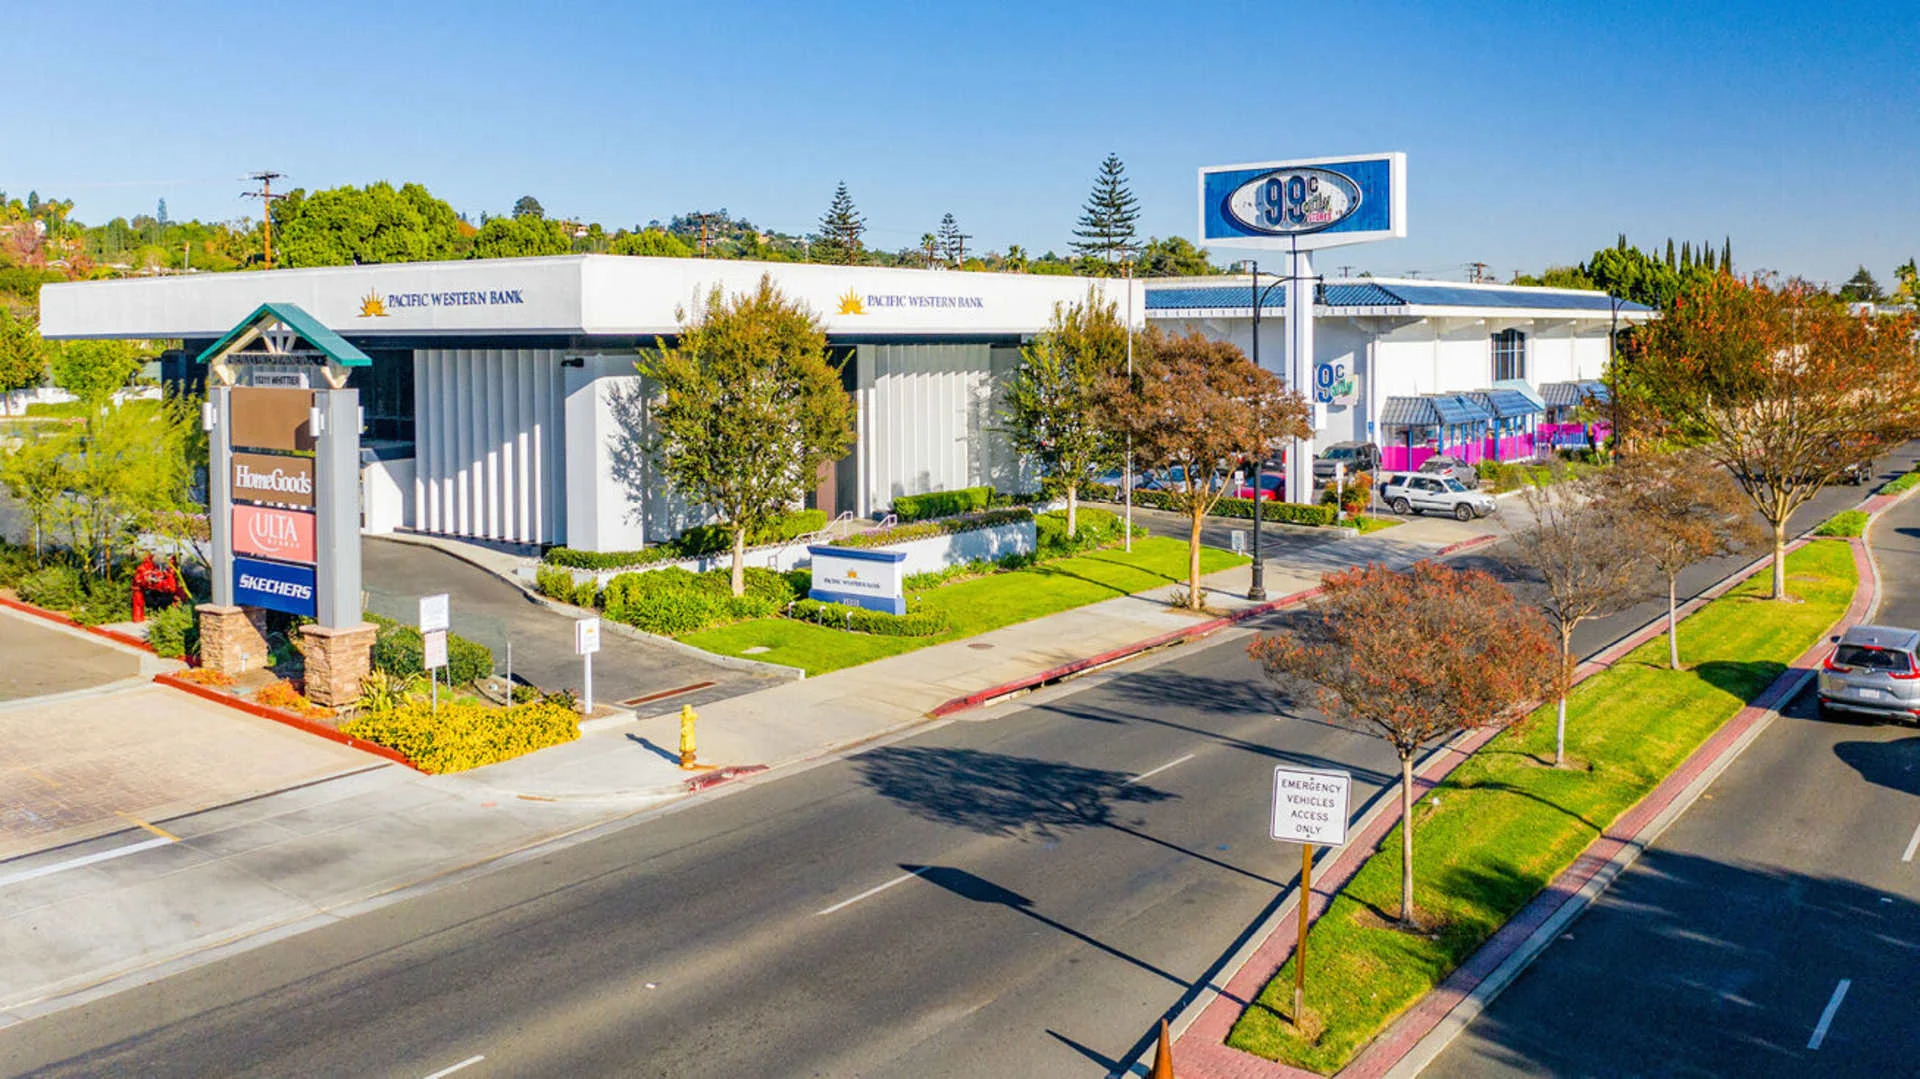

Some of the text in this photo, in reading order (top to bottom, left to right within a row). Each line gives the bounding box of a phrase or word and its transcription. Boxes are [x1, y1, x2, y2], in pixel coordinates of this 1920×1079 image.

[388, 289, 524, 308] PACIFIC WESTERN BANK
[867, 295, 984, 309] PACIFIC WESTERN BANK
[236, 464, 312, 494] HomeGoods
[255, 512, 298, 542] ULTA
[239, 573, 313, 600] SKECHERS
[1281, 779, 1342, 794] EMERGENCY
[1287, 794, 1335, 808] VEHICLES
[1291, 810, 1329, 822] ACCESS
[1295, 824, 1321, 834] ONLY
